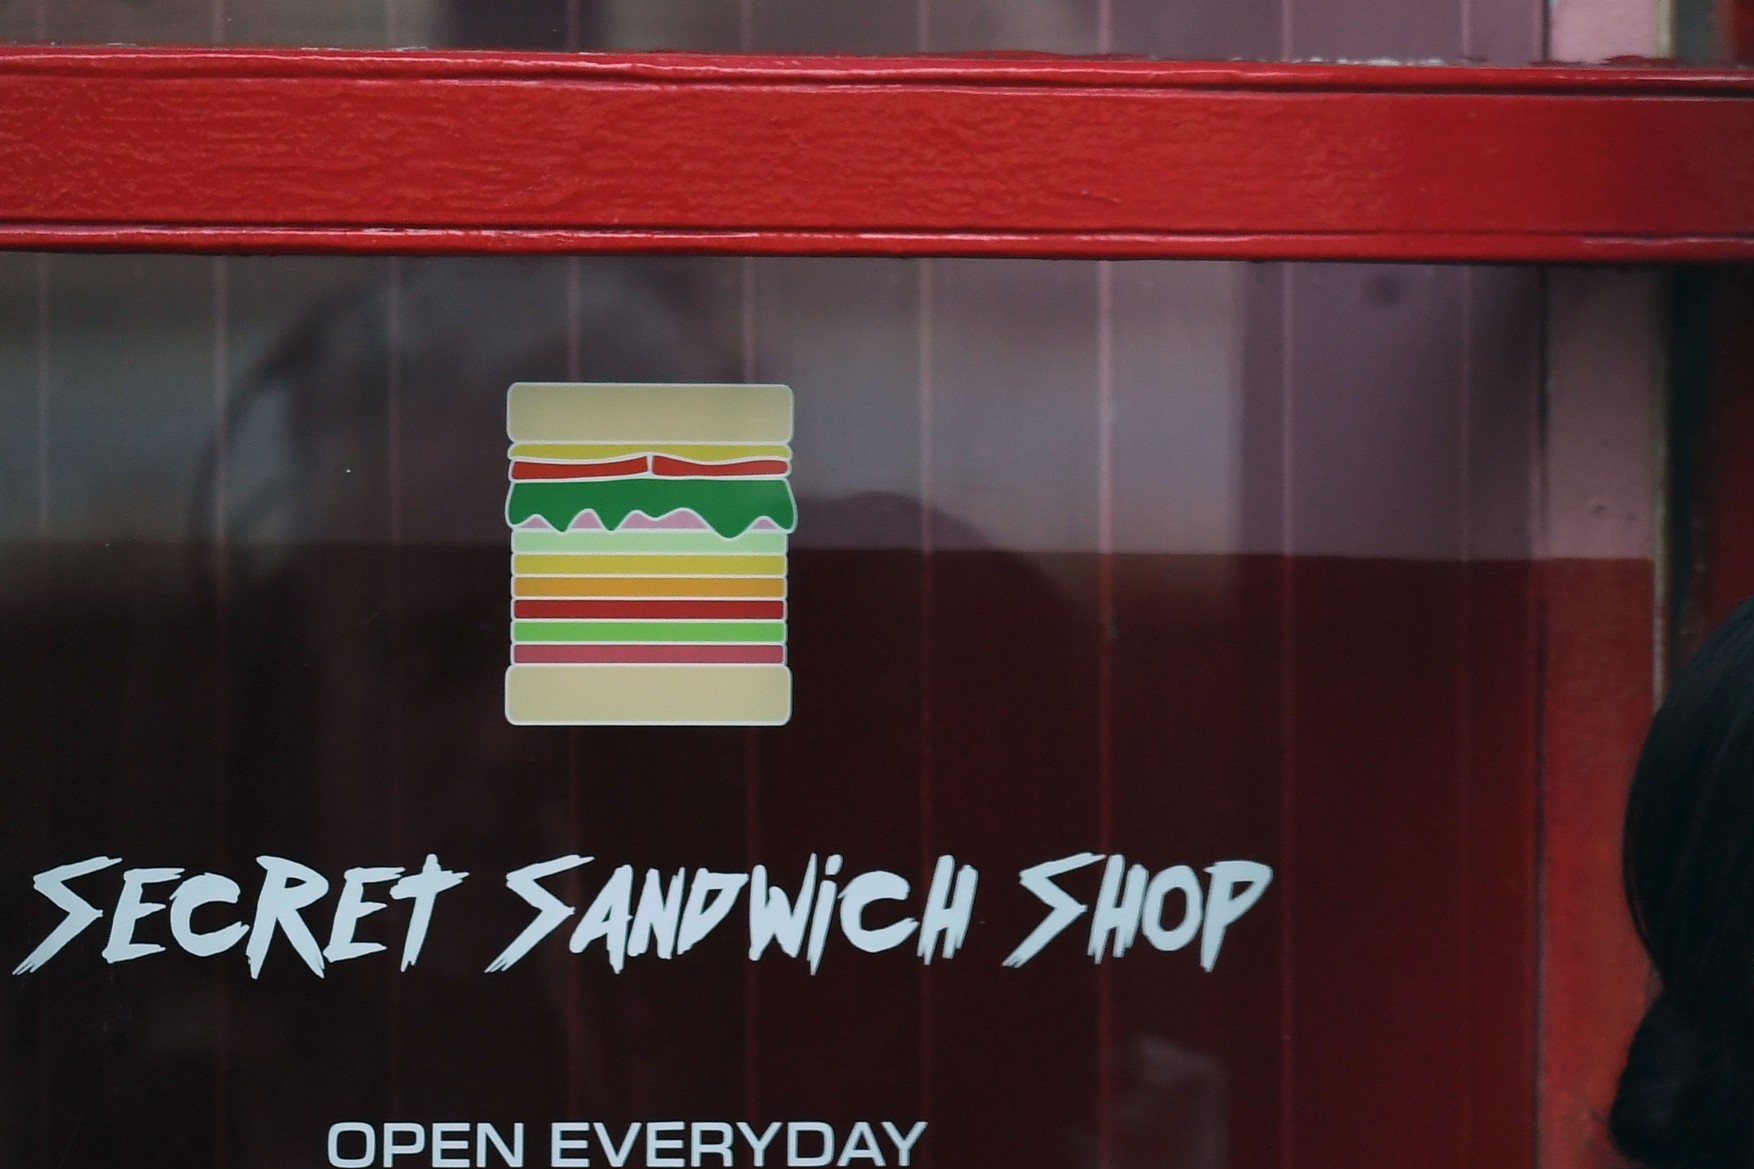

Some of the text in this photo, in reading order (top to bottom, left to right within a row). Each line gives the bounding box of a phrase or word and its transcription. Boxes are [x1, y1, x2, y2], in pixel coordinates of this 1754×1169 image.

[14, 855, 470, 980] SECRET
[1004, 854, 1272, 972] SHOP
[329, 1123, 928, 1169] OPEN EVERYDAY
